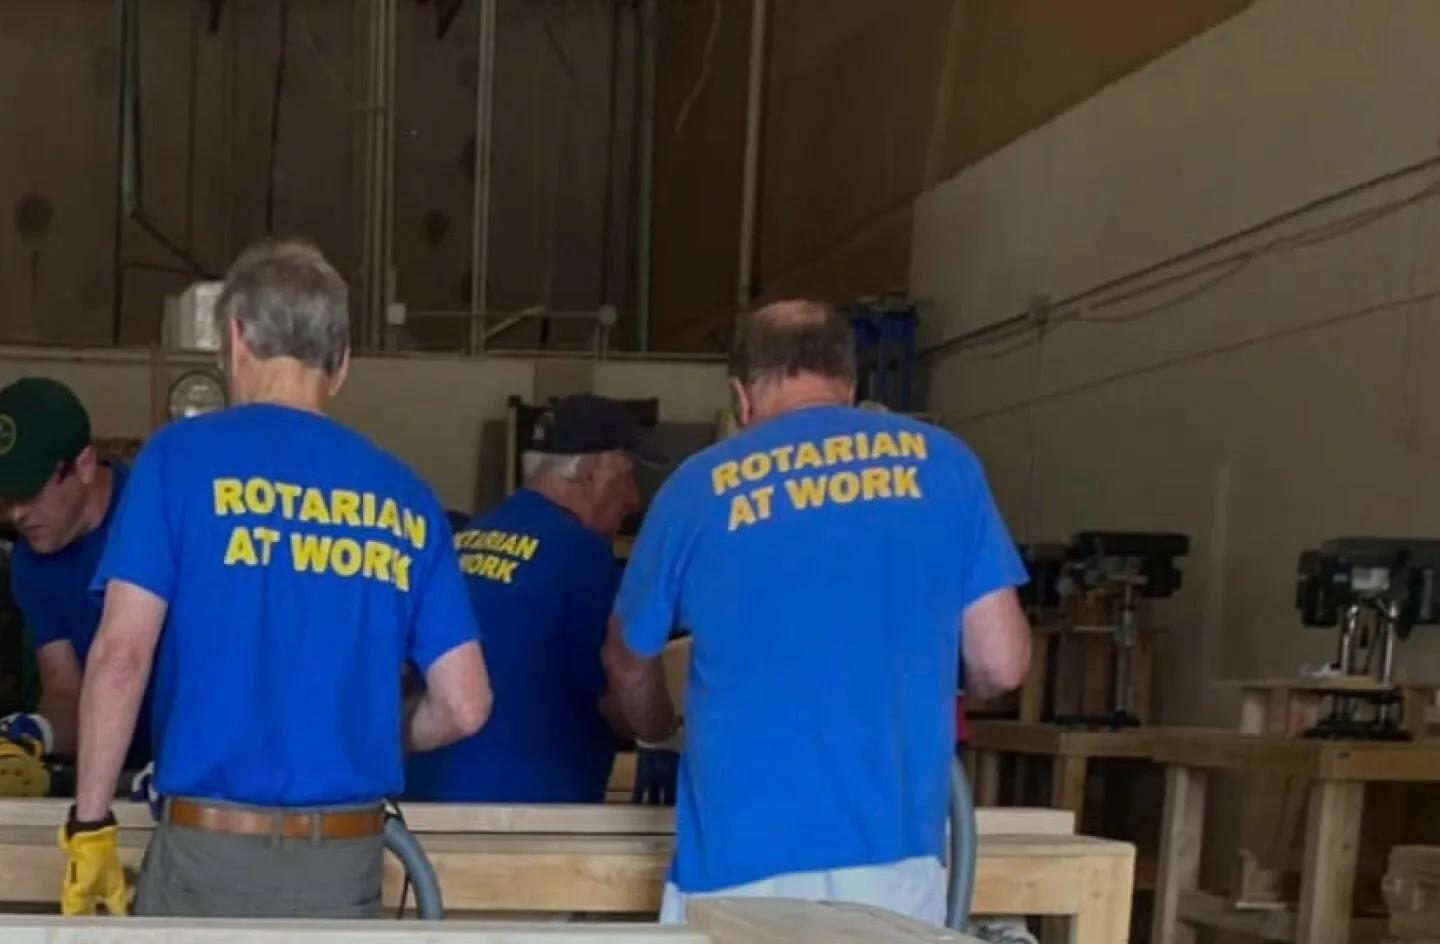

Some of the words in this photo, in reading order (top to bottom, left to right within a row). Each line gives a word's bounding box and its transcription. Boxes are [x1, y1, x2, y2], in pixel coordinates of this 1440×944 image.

[712, 430, 927, 496] ROTARIAN
[213, 476, 427, 549] ROTARIAN
[728, 485, 774, 532] AT
[785, 465, 922, 510] WORK
[223, 526, 280, 566] AT
[290, 533, 413, 592] WORK
